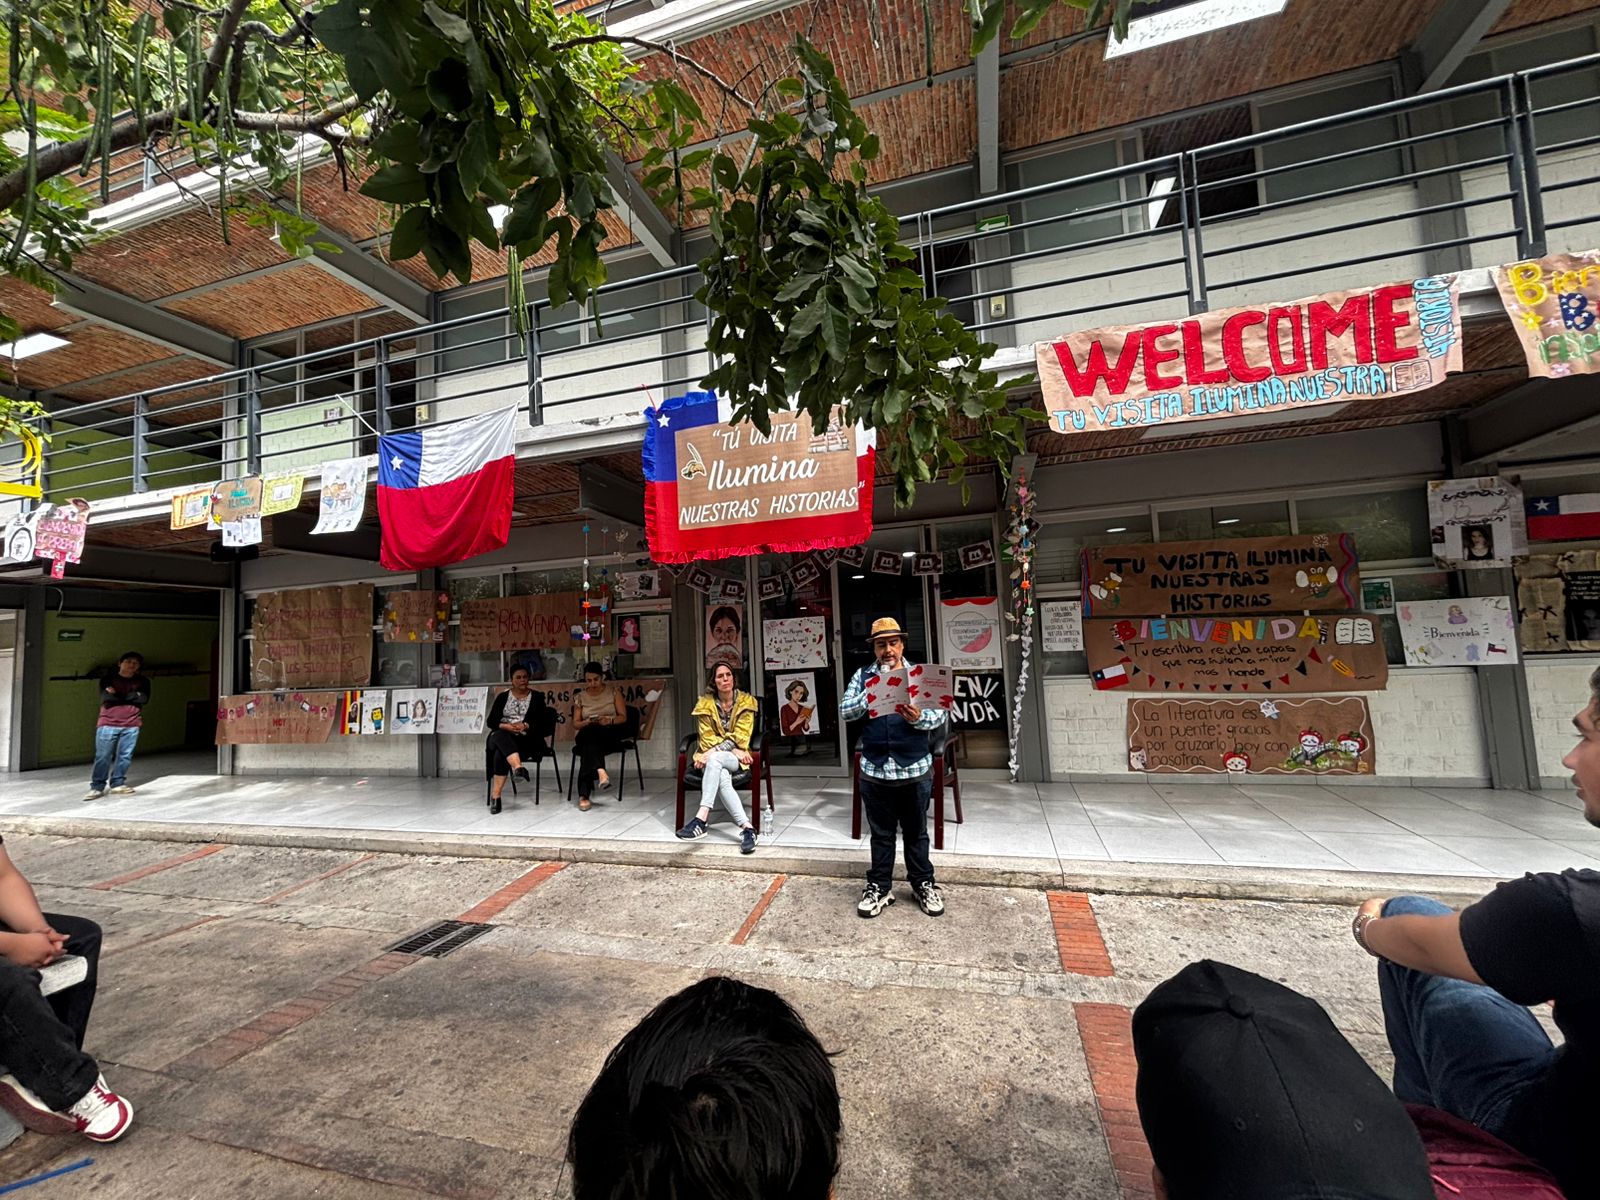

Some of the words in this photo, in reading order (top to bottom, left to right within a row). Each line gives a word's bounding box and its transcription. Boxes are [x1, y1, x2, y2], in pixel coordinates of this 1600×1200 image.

[1053, 283, 1420, 398] WELCOME
[1053, 409, 1086, 432] TU
[1092, 394, 1182, 428] VISITA
[1189, 377, 1288, 417] ILUMINA
[1287, 364, 1387, 403] NUESTRA
[708, 455, 821, 492] Ilumina
[679, 498, 760, 526] NUESTRAS
[1103, 557, 1146, 574] TU
[1158, 550, 1239, 572] VISITA
[1246, 547, 1333, 567] ILUMINA
[1151, 569, 1271, 589] NUESTRAS
[1170, 593, 1273, 613] HISTORIAS
[498, 608, 569, 637] BIENVENIDA
[1115, 617, 1321, 645] BIENVENIDA
[1429, 627, 1480, 640] Bienvenida
[1129, 642, 1149, 657] Tu
[1151, 641, 1204, 657] escritura
[1255, 644, 1297, 656] capas
[1161, 659, 1182, 668] que
[1258, 655, 1292, 664] mirar
[1143, 705, 1160, 721] La
[1168, 705, 1235, 721] literatura
[1242, 708, 1259, 720] es
[1144, 725, 1163, 737] un
[1170, 723, 1222, 739] puente:
[1226, 725, 1271, 738] gracias
[1146, 740, 1167, 752] por
[1175, 738, 1227, 751] cruzarlo
[1234, 738, 1260, 753] hoy
[1264, 741, 1289, 751] con
[1150, 751, 1207, 767] nosotros
